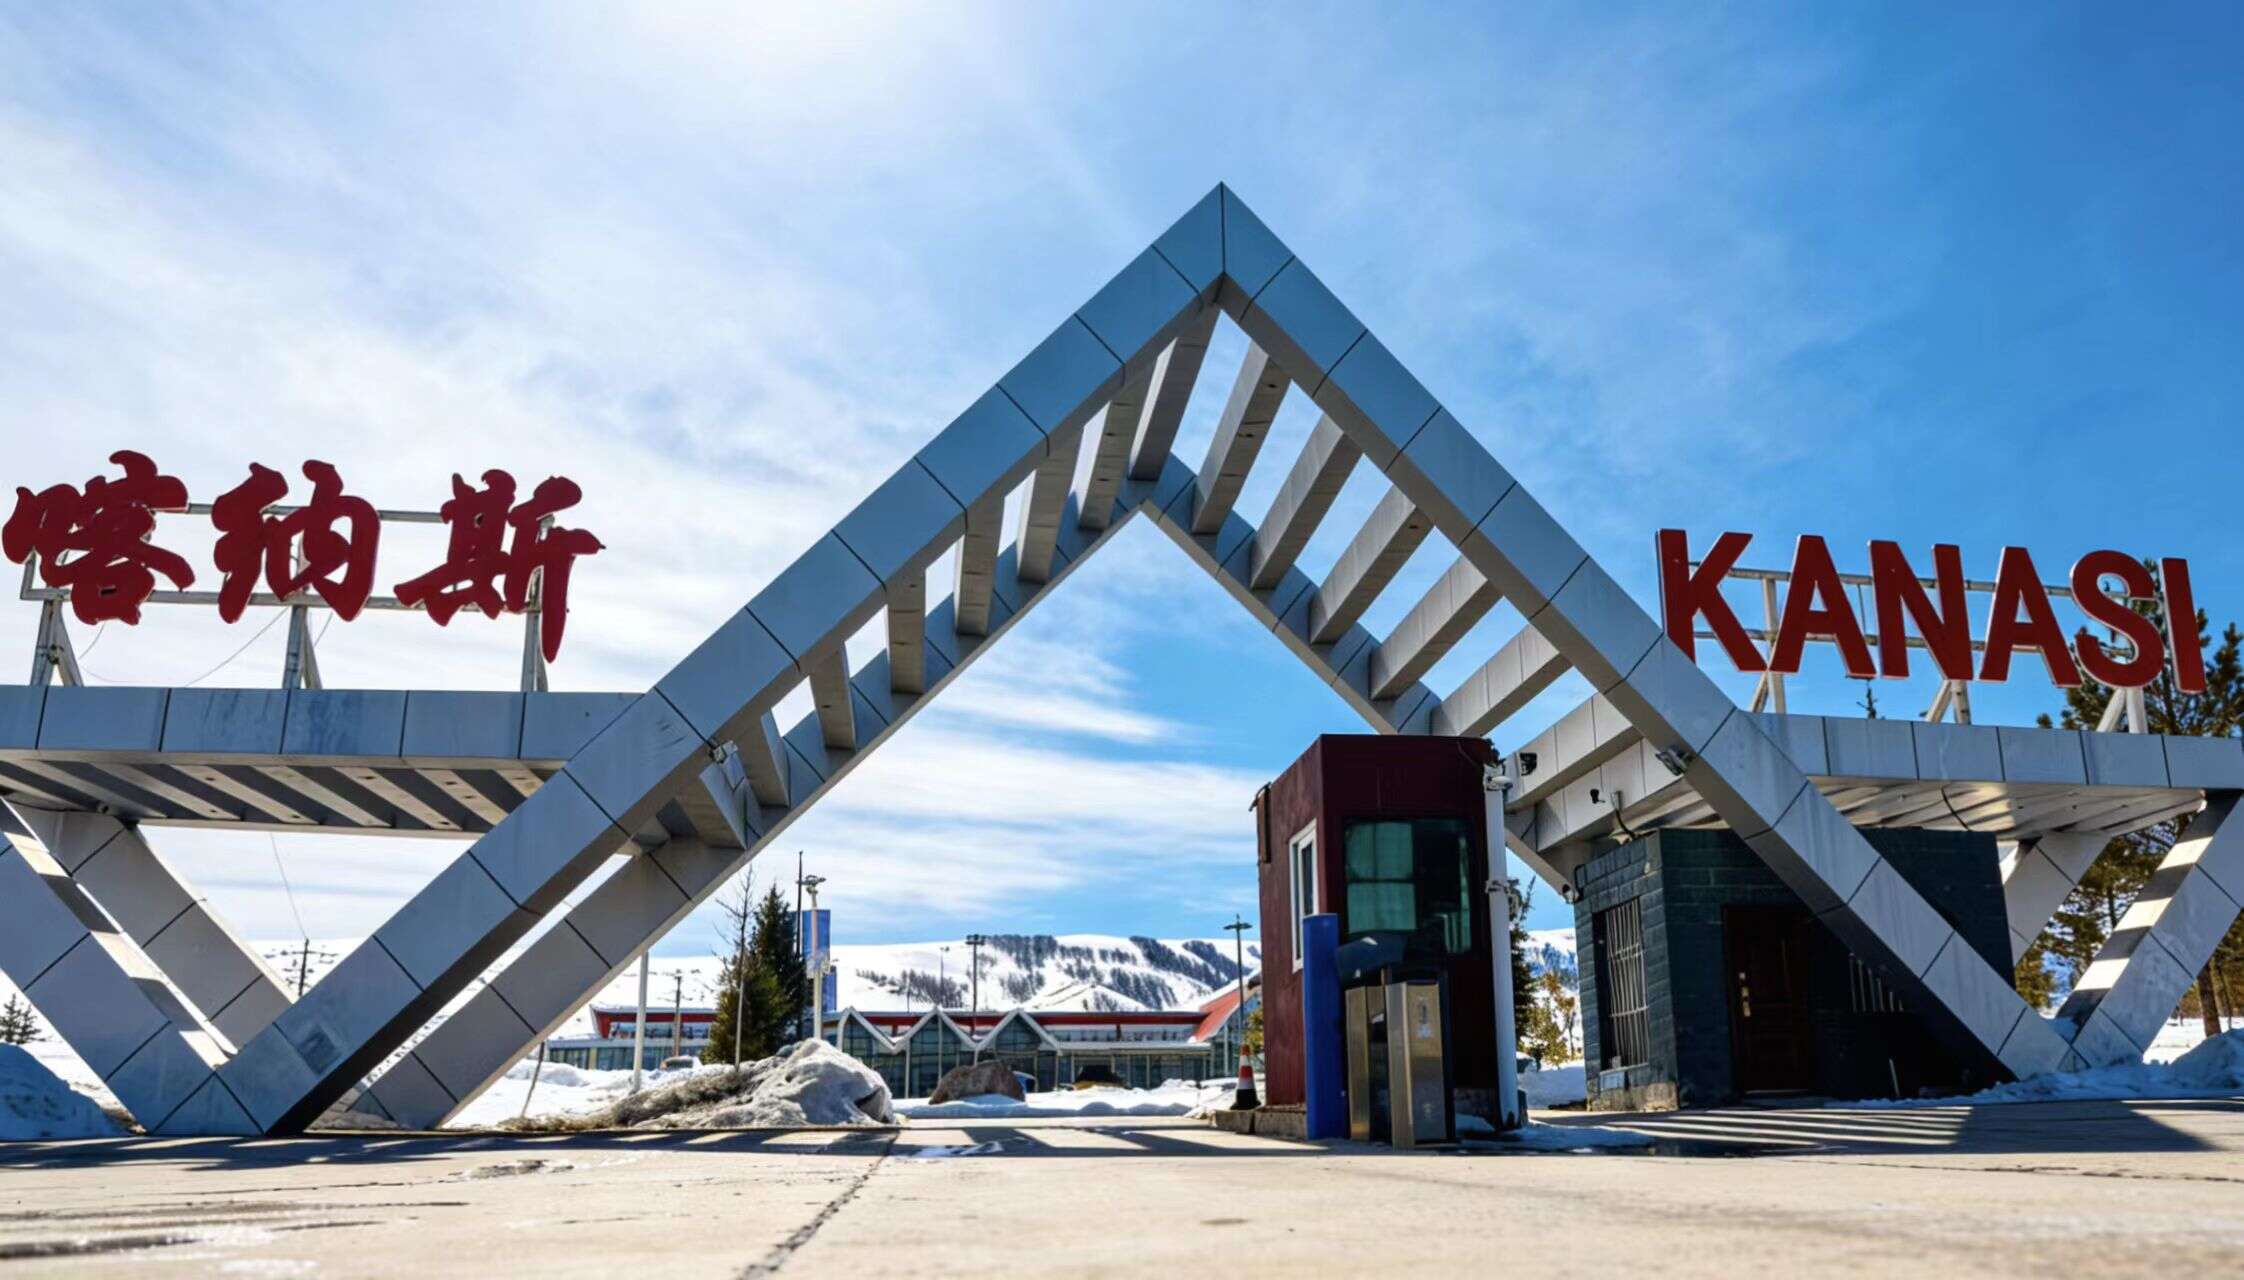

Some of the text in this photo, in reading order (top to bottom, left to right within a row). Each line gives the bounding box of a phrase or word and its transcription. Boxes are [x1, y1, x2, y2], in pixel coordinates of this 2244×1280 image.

[2, 450, 604, 662] 喀纳斯
[1656, 528, 2207, 694] KANASI
